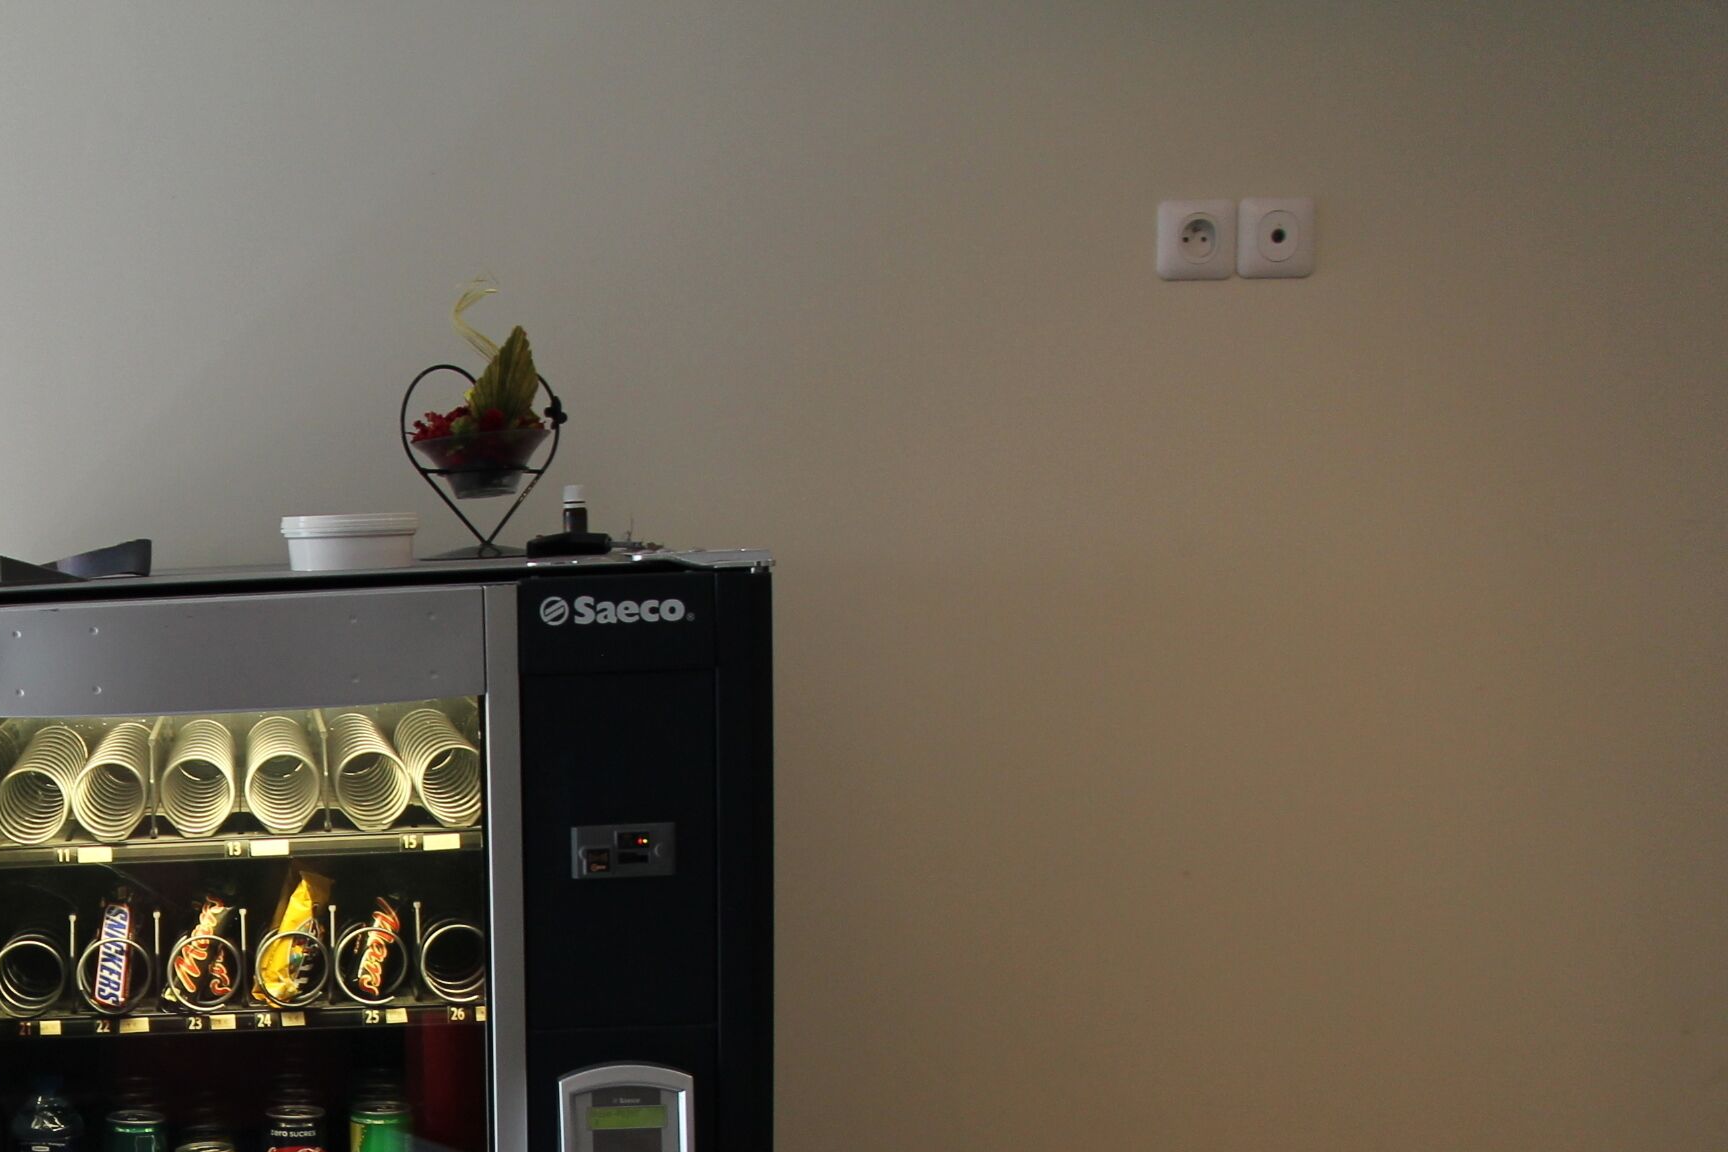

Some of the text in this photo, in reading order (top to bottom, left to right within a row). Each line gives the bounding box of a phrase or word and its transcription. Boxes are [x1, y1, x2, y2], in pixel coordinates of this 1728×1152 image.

[574, 595, 685, 624] Saeco
[226, 841, 242, 856] 13
[403, 834, 417, 850] 15
[57, 848, 71, 863] 11
[97, 904, 129, 1006] SNICKERS
[257, 1013, 271, 1028] 24
[365, 1010, 380, 1024] 25
[450, 1007, 465, 1021] 26
[18, 1022, 32, 1035] 21
[96, 1020, 110, 1033] 22
[188, 1018, 203, 1030] 23
